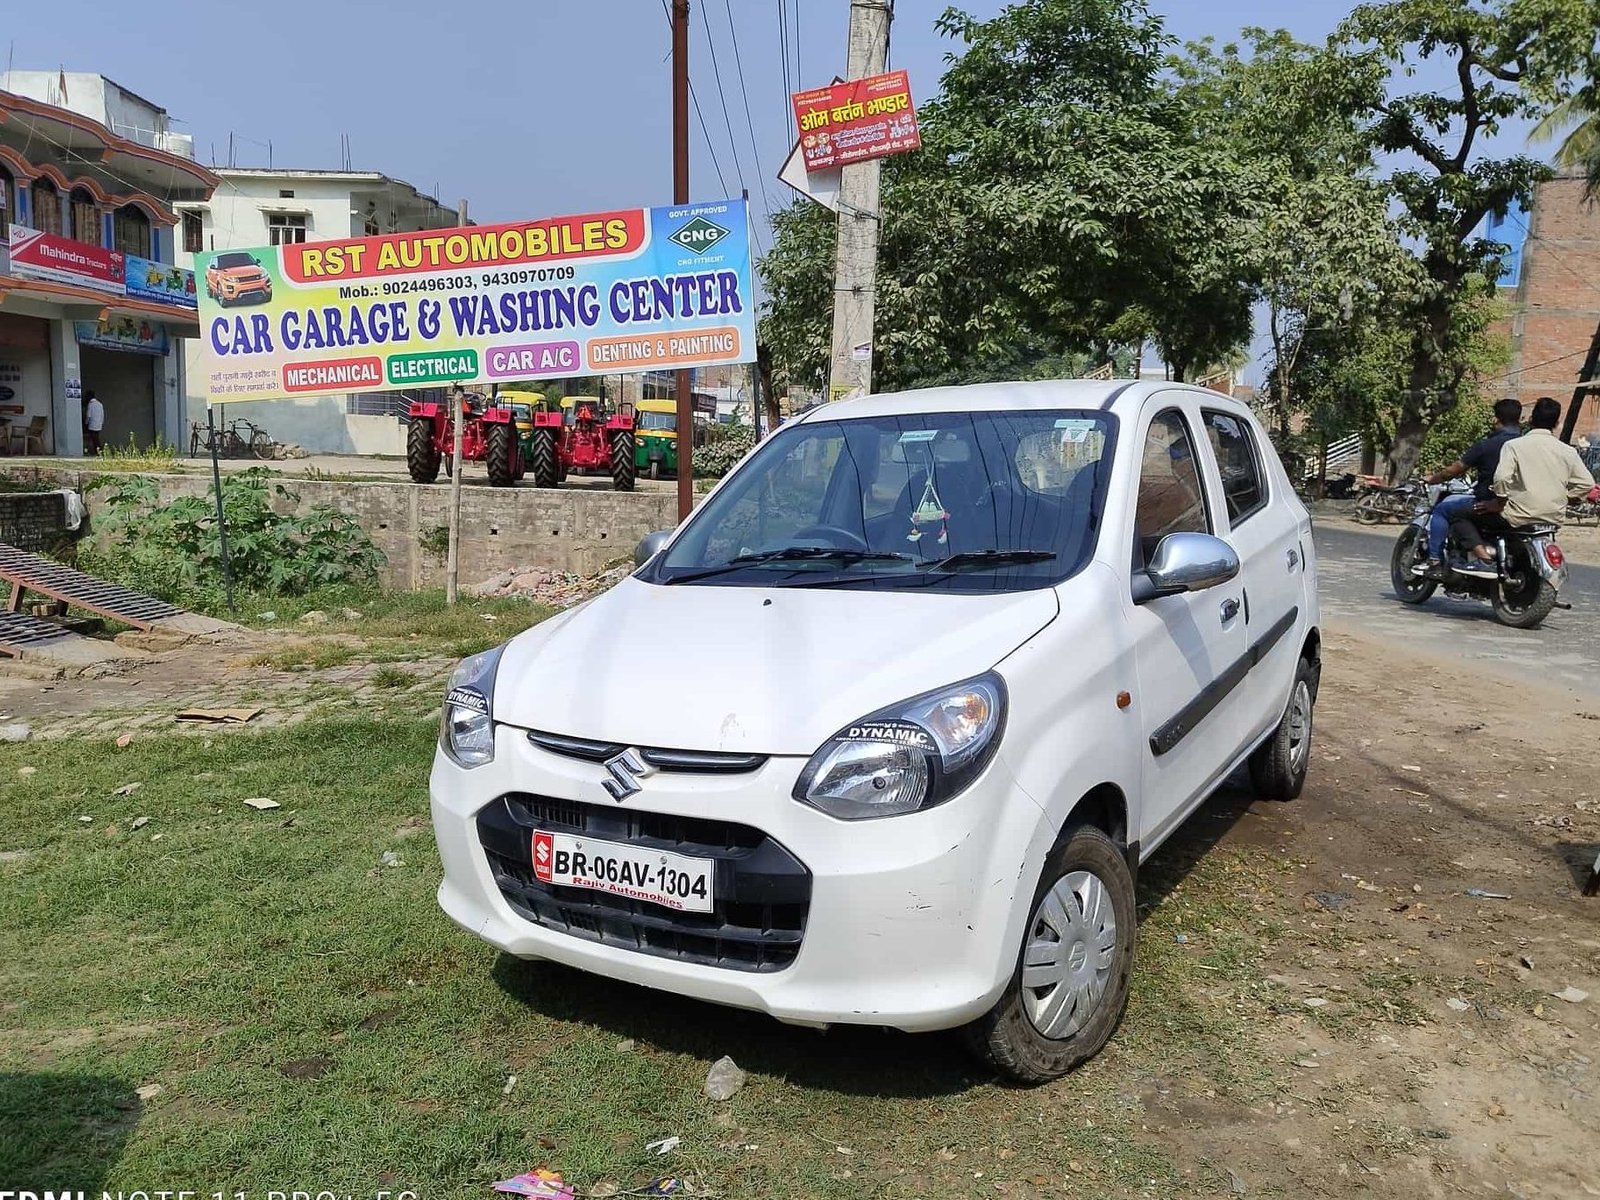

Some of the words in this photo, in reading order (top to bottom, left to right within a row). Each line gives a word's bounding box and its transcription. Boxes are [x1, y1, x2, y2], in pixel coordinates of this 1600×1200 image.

[800, 108, 829, 131] ओम
[867, 93, 909, 115] भण्डार
[668, 210, 689, 219] GOVT.
[690, 206, 727, 216] APPROVED
[301, 245, 366, 277] RST
[376, 218, 628, 271] AUTOMOBILES
[679, 227, 718, 243] CNG
[339, 284, 379, 299] Mob.:
[382, 275, 477, 295] 9024496303,
[482, 266, 575, 287] 9430970709
[210, 314, 274, 356] CAR
[280, 301, 410, 351] GARAGE
[417, 298, 441, 340] &
[449, 284, 601, 336] WASHING
[609, 270, 743, 324] CENTER
[492, 351, 536, 372] CAR
[540, 347, 573, 369] A/C
[592, 340, 652, 363] DENTING
[656, 339, 666, 356] &
[669, 333, 733, 355] PAINTING
[286, 363, 379, 387] MECHANICAL
[391, 355, 476, 378] ELECTRICAL
[448, 691, 486, 708] DYNAMIC
[848, 727, 928, 745] DYNAMIC
[554, 850, 708, 900] BR-06AV-1304
[572, 876, 606, 890] Rajiv
[608, 882, 685, 910] Automobiles
